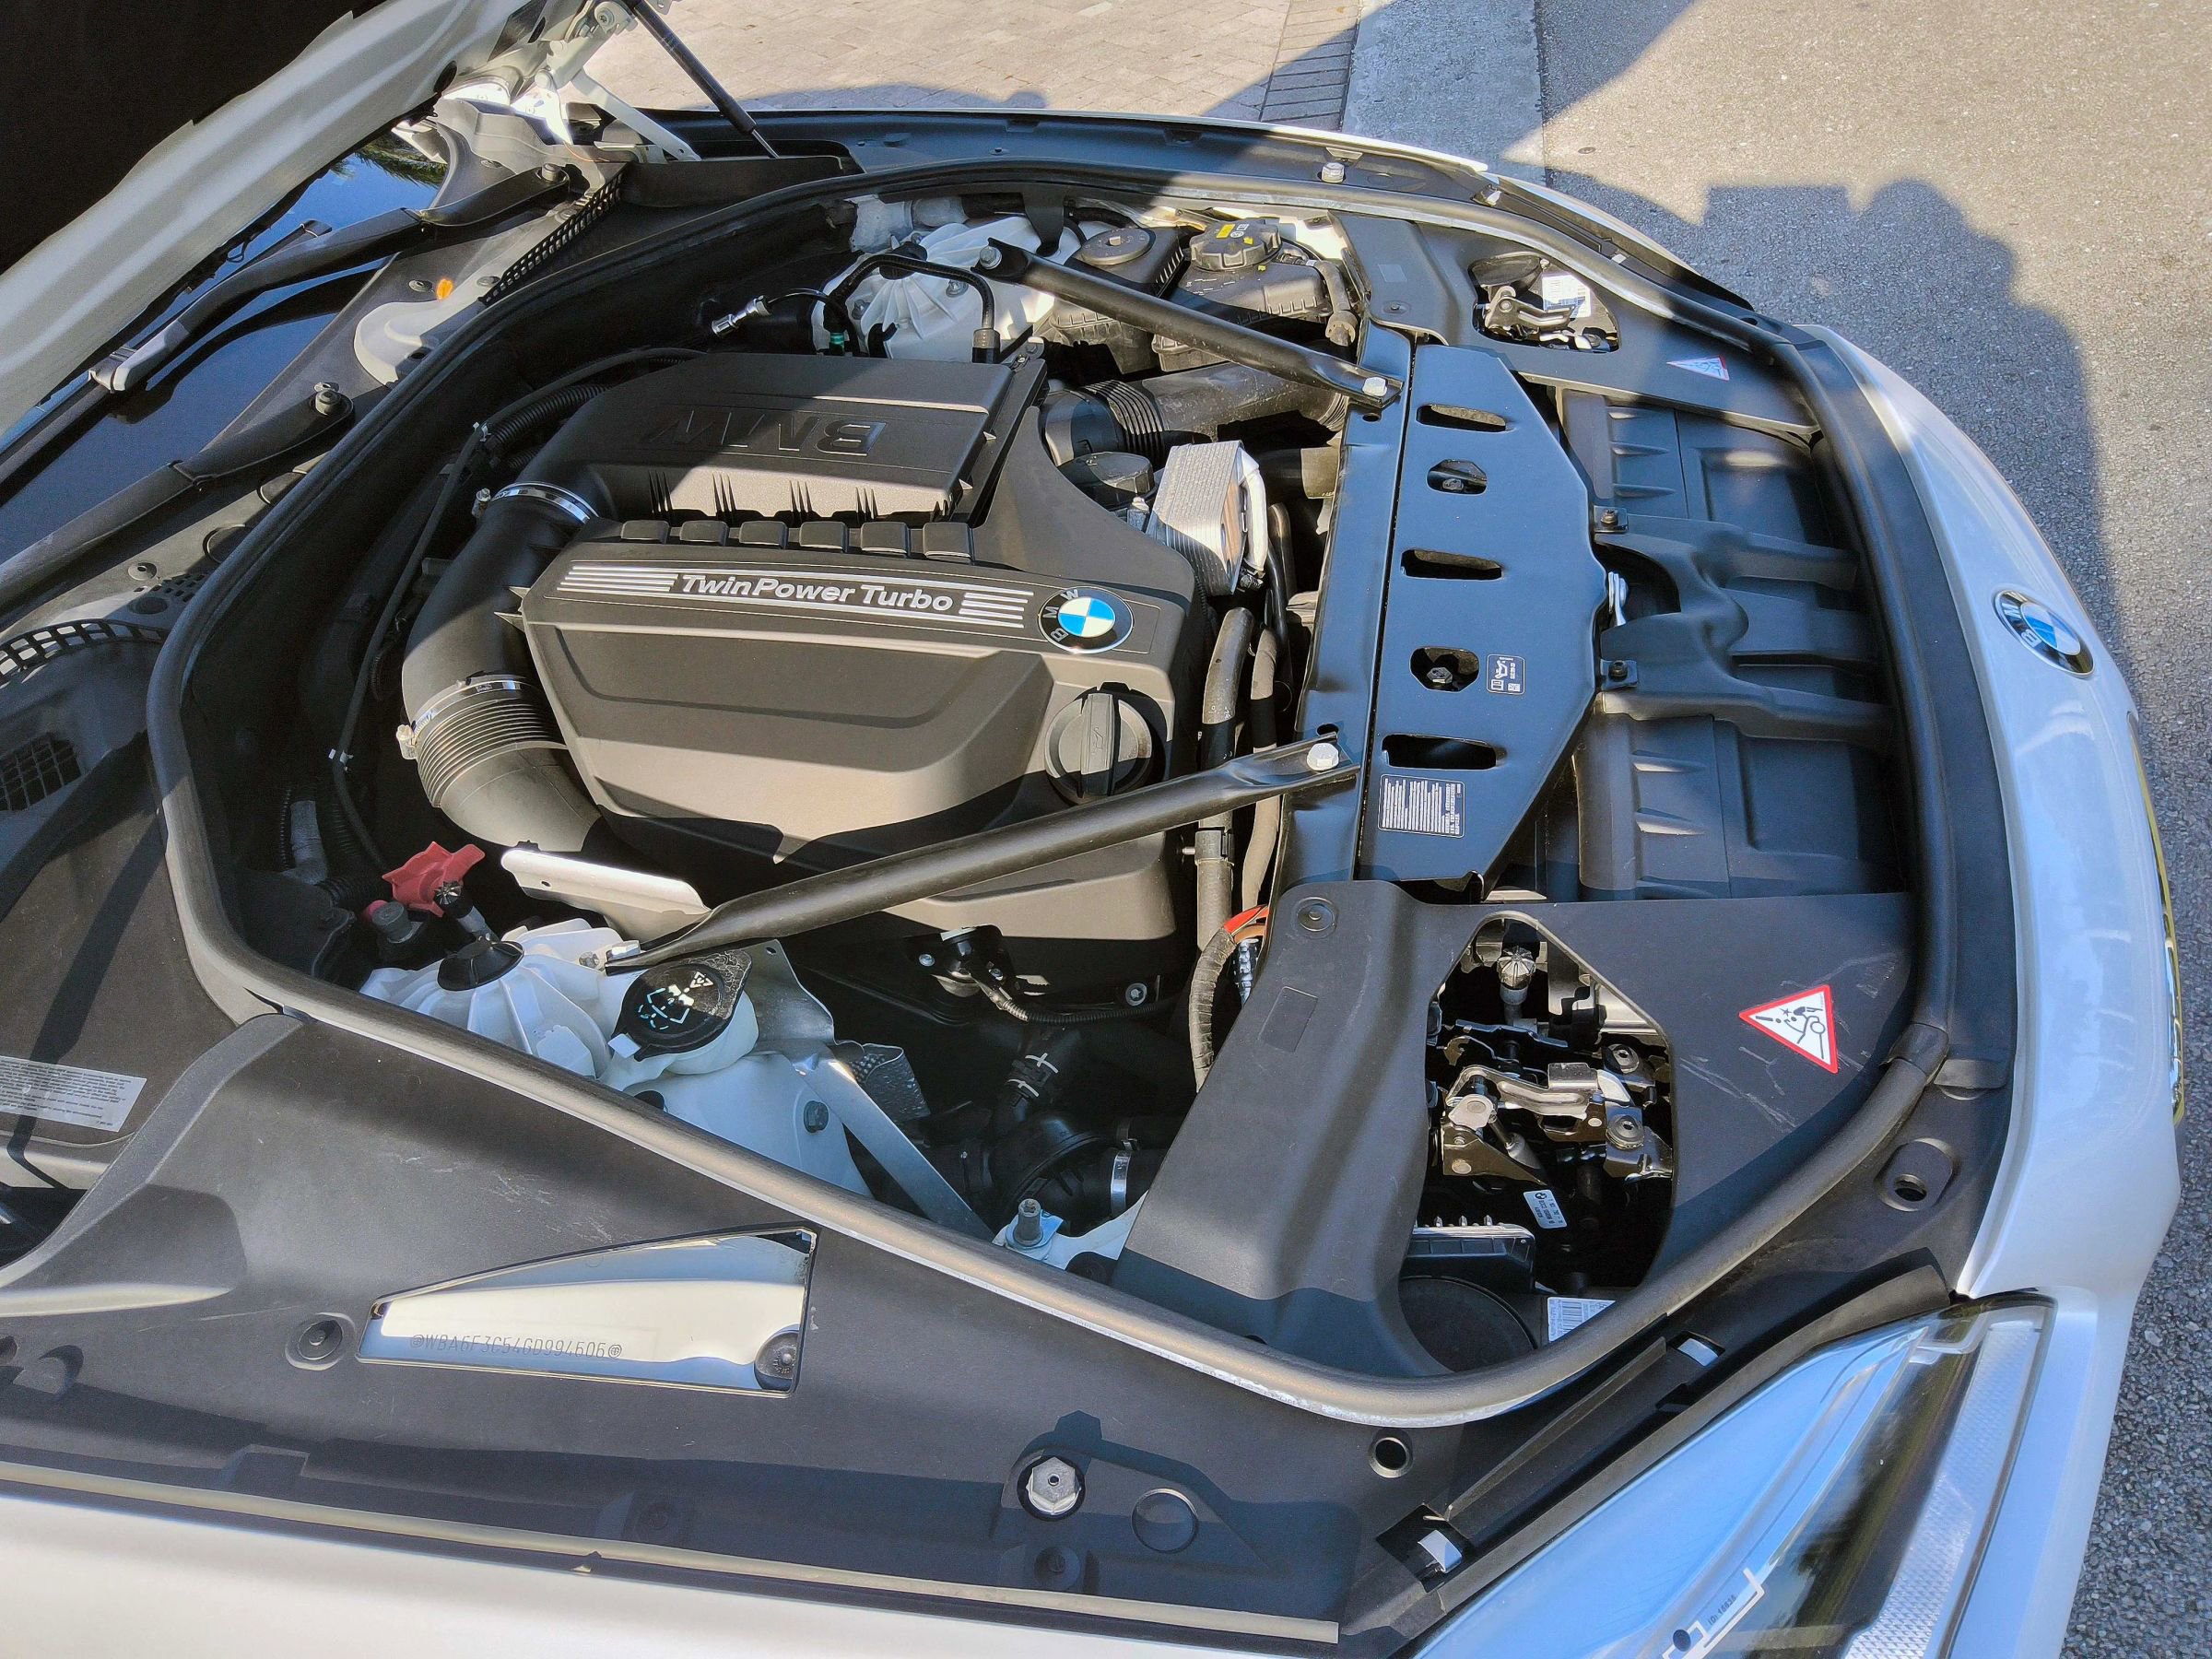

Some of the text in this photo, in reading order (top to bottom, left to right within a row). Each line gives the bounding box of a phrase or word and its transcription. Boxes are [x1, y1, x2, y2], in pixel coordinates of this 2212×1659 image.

[638, 411, 888, 457] BMW
[682, 574, 954, 611] TwinPower Turbo
[1042, 589, 1079, 642] BMW
[2001, 591, 2043, 647] BMW
